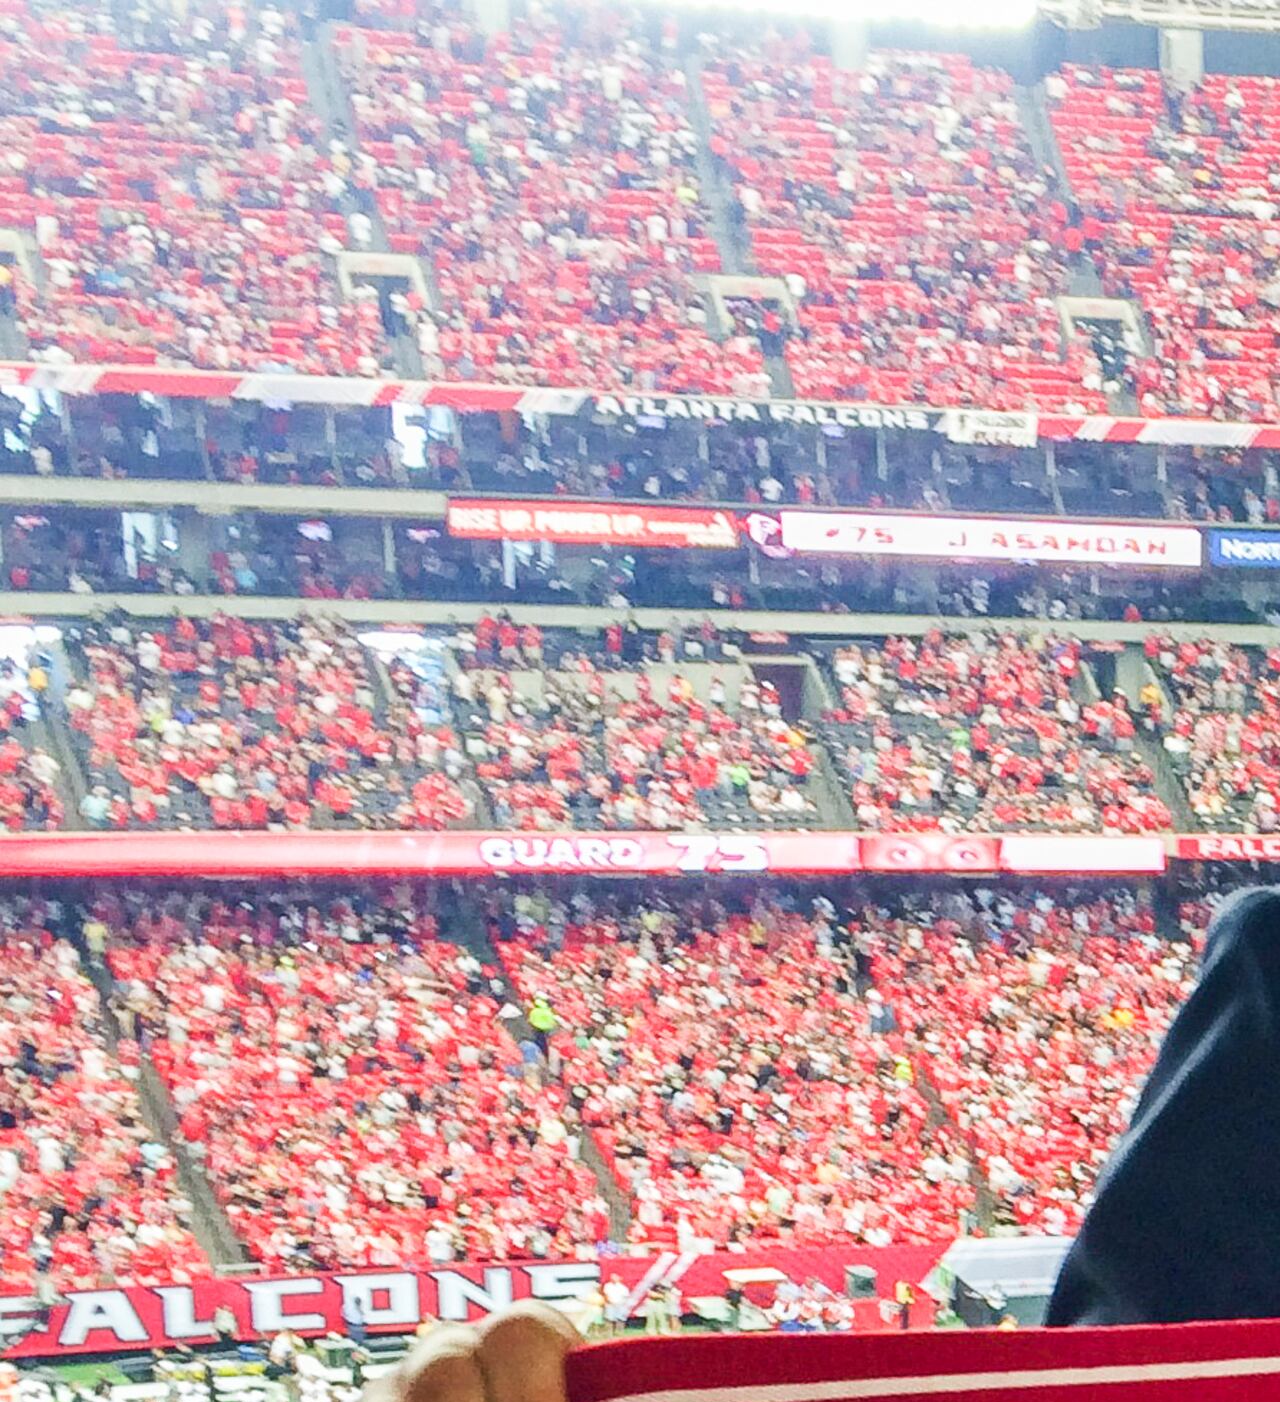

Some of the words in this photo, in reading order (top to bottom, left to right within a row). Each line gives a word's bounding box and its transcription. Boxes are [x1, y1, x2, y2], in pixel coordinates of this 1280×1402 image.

[595, 395, 761, 421] ATLANTA
[769, 404, 930, 429] FALCONS
[480, 838, 645, 868] GUARD
[666, 835, 770, 871] 75
